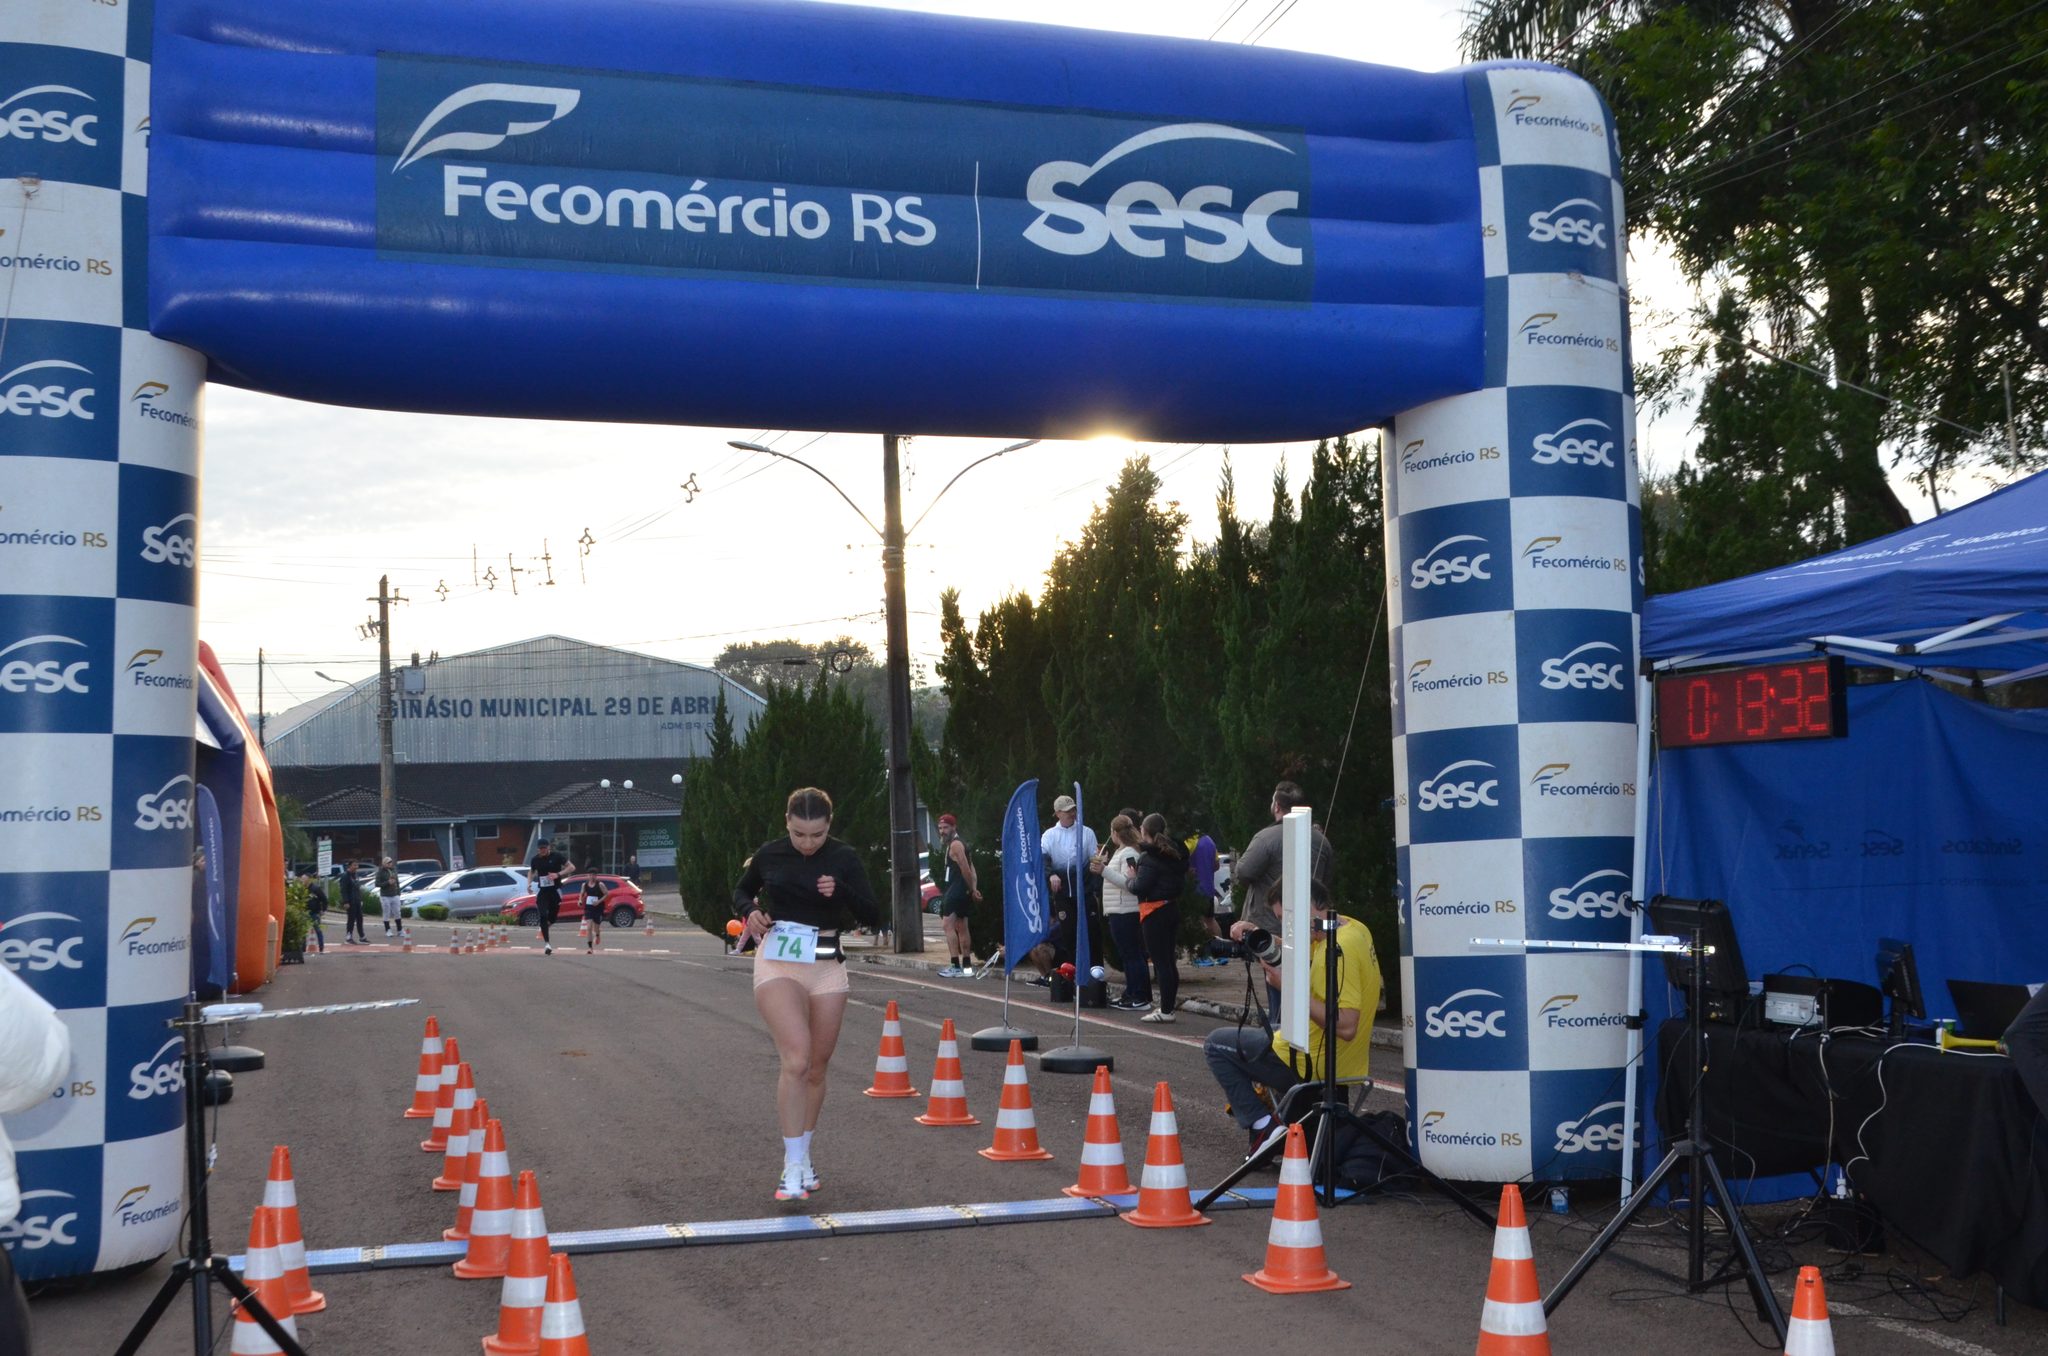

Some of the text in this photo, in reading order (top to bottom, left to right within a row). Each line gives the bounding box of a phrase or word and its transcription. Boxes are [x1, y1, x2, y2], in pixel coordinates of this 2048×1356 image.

[0, 108, 98, 147] esc
[1515, 113, 1590, 132] Fecomércio
[444, 164, 937, 246] Fecomércio RS
[1022, 160, 1303, 266] Sesc
[1528, 211, 1607, 249] Sesc
[86, 258, 112, 276] RS
[1528, 331, 1619, 352] Fecomércio RS
[0, 384, 95, 420] esc
[1404, 446, 1501, 474] Fecomércio RS
[1531, 433, 1615, 468] Sesc
[82, 532, 108, 548] RS
[1410, 553, 1491, 589] Sesc
[1532, 555, 1611, 570] Fecomércio
[1614, 557, 1627, 572] RS
[0, 660, 90, 694] esc
[1412, 673, 1483, 693] Fecomércio
[1487, 671, 1509, 685] RS
[1539, 658, 1624, 691] Sesc
[480, 697, 597, 718] MUNICIPAL
[604, 697, 631, 716] 29
[638, 697, 664, 715] DE
[670, 696, 717, 716] ABRI
[1687, 665, 1829, 741] 0:13:32
[1418, 779, 1499, 812] Sesc
[1540, 782, 1636, 796] Fecomércio RS
[77, 806, 102, 821] RS
[1419, 900, 1490, 916] Fecomércio
[1495, 900, 1517, 914] RS
[777, 935, 802, 958] 74
[1425, 1005, 1507, 1038] Sesc
[71, 1081, 96, 1097] RS
[1425, 1131, 1496, 1147] Fecomércio
[1501, 1133, 1523, 1147] RS
